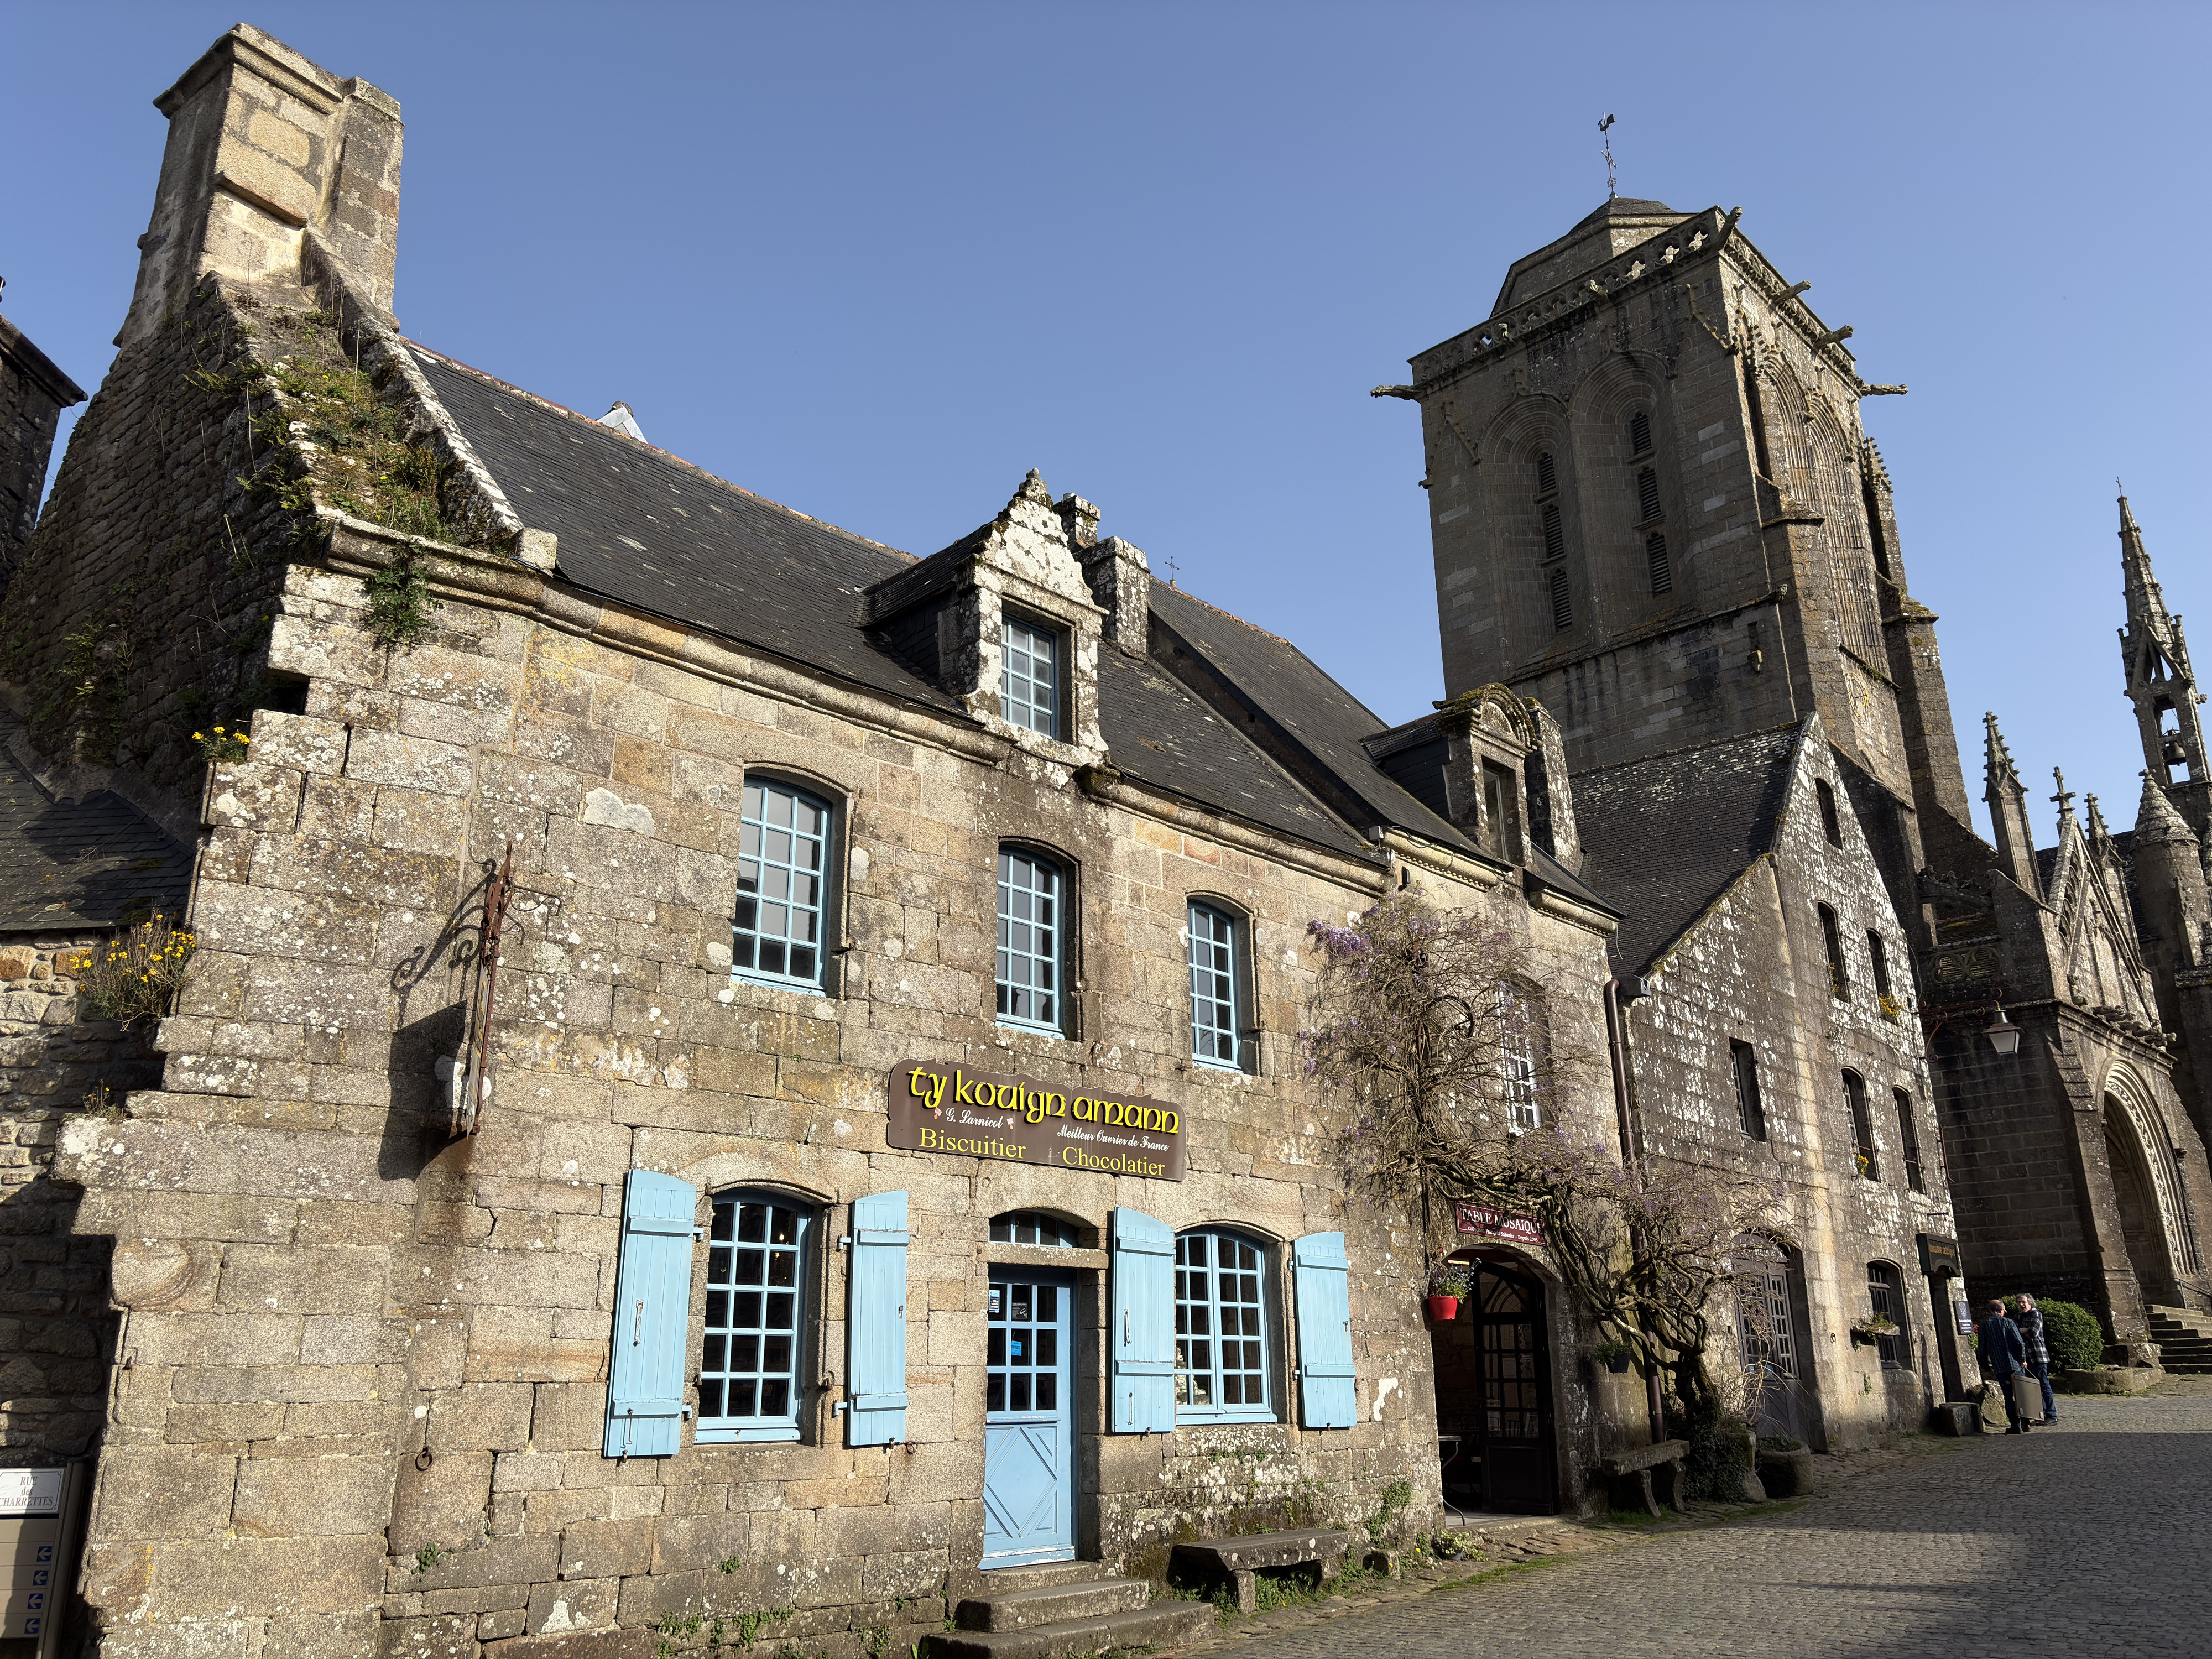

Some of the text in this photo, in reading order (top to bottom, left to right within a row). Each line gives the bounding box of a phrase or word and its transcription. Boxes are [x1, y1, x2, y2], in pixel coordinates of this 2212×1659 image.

[908, 1067, 948, 1108] ty
[1073, 1097, 1179, 1134] amann
[946, 1108, 1004, 1129] G. Larnicol
[919, 1128, 1026, 1159] Biscuitier
[1057, 1124, 1170, 1151] Meilleur Ouvrier de France
[1062, 1146, 1165, 1176] Chocolatier
[1460, 1208, 1543, 1235] TABLE MOSAIQUE
[20, 1476, 38, 1485] RUE
[21, 1486, 33, 1496] des
[0, 1496, 54, 1506] CHARRETTES
